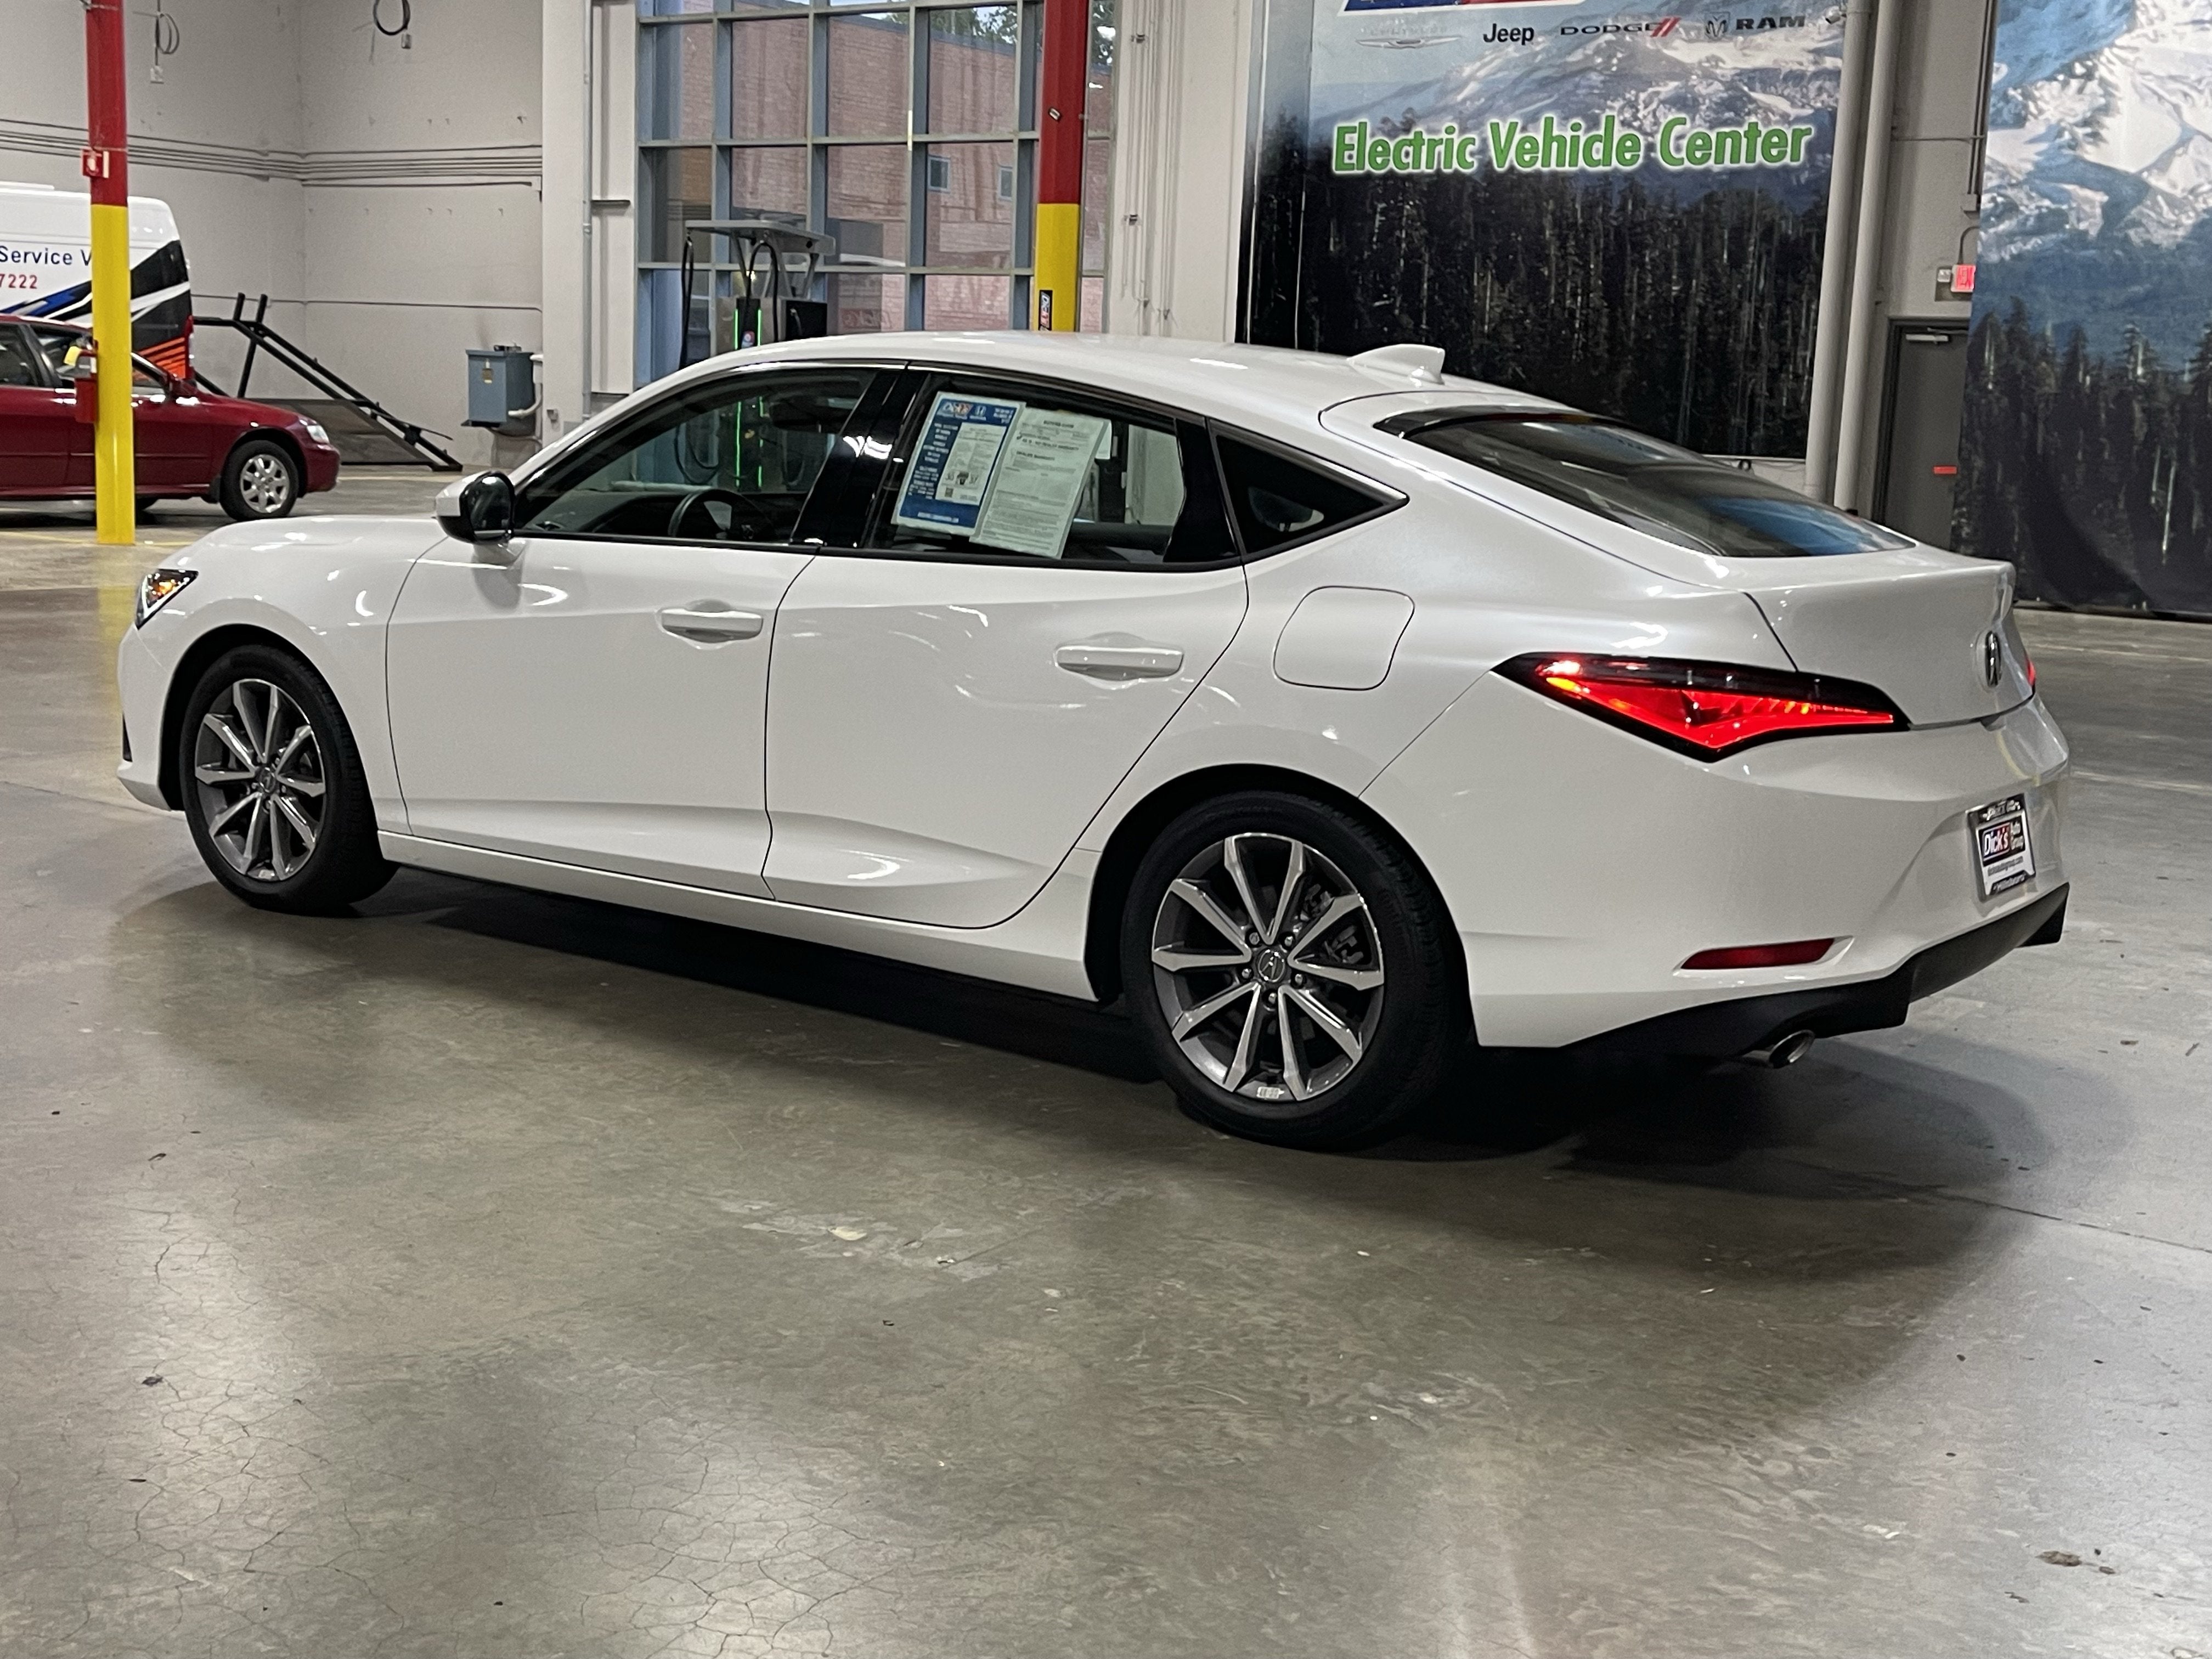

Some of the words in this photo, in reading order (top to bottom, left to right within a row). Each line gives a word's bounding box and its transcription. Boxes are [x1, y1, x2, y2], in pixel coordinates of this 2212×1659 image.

[1483, 23, 1535, 45] Jeep
[1736, 16, 1805, 30] RAM
[1334, 121, 1476, 172] Electric
[1489, 114, 1641, 168] Vehicle
[1659, 116, 1813, 167] Center
[0, 245, 72, 265] Service
[1984, 825, 2008, 856] Dick's
